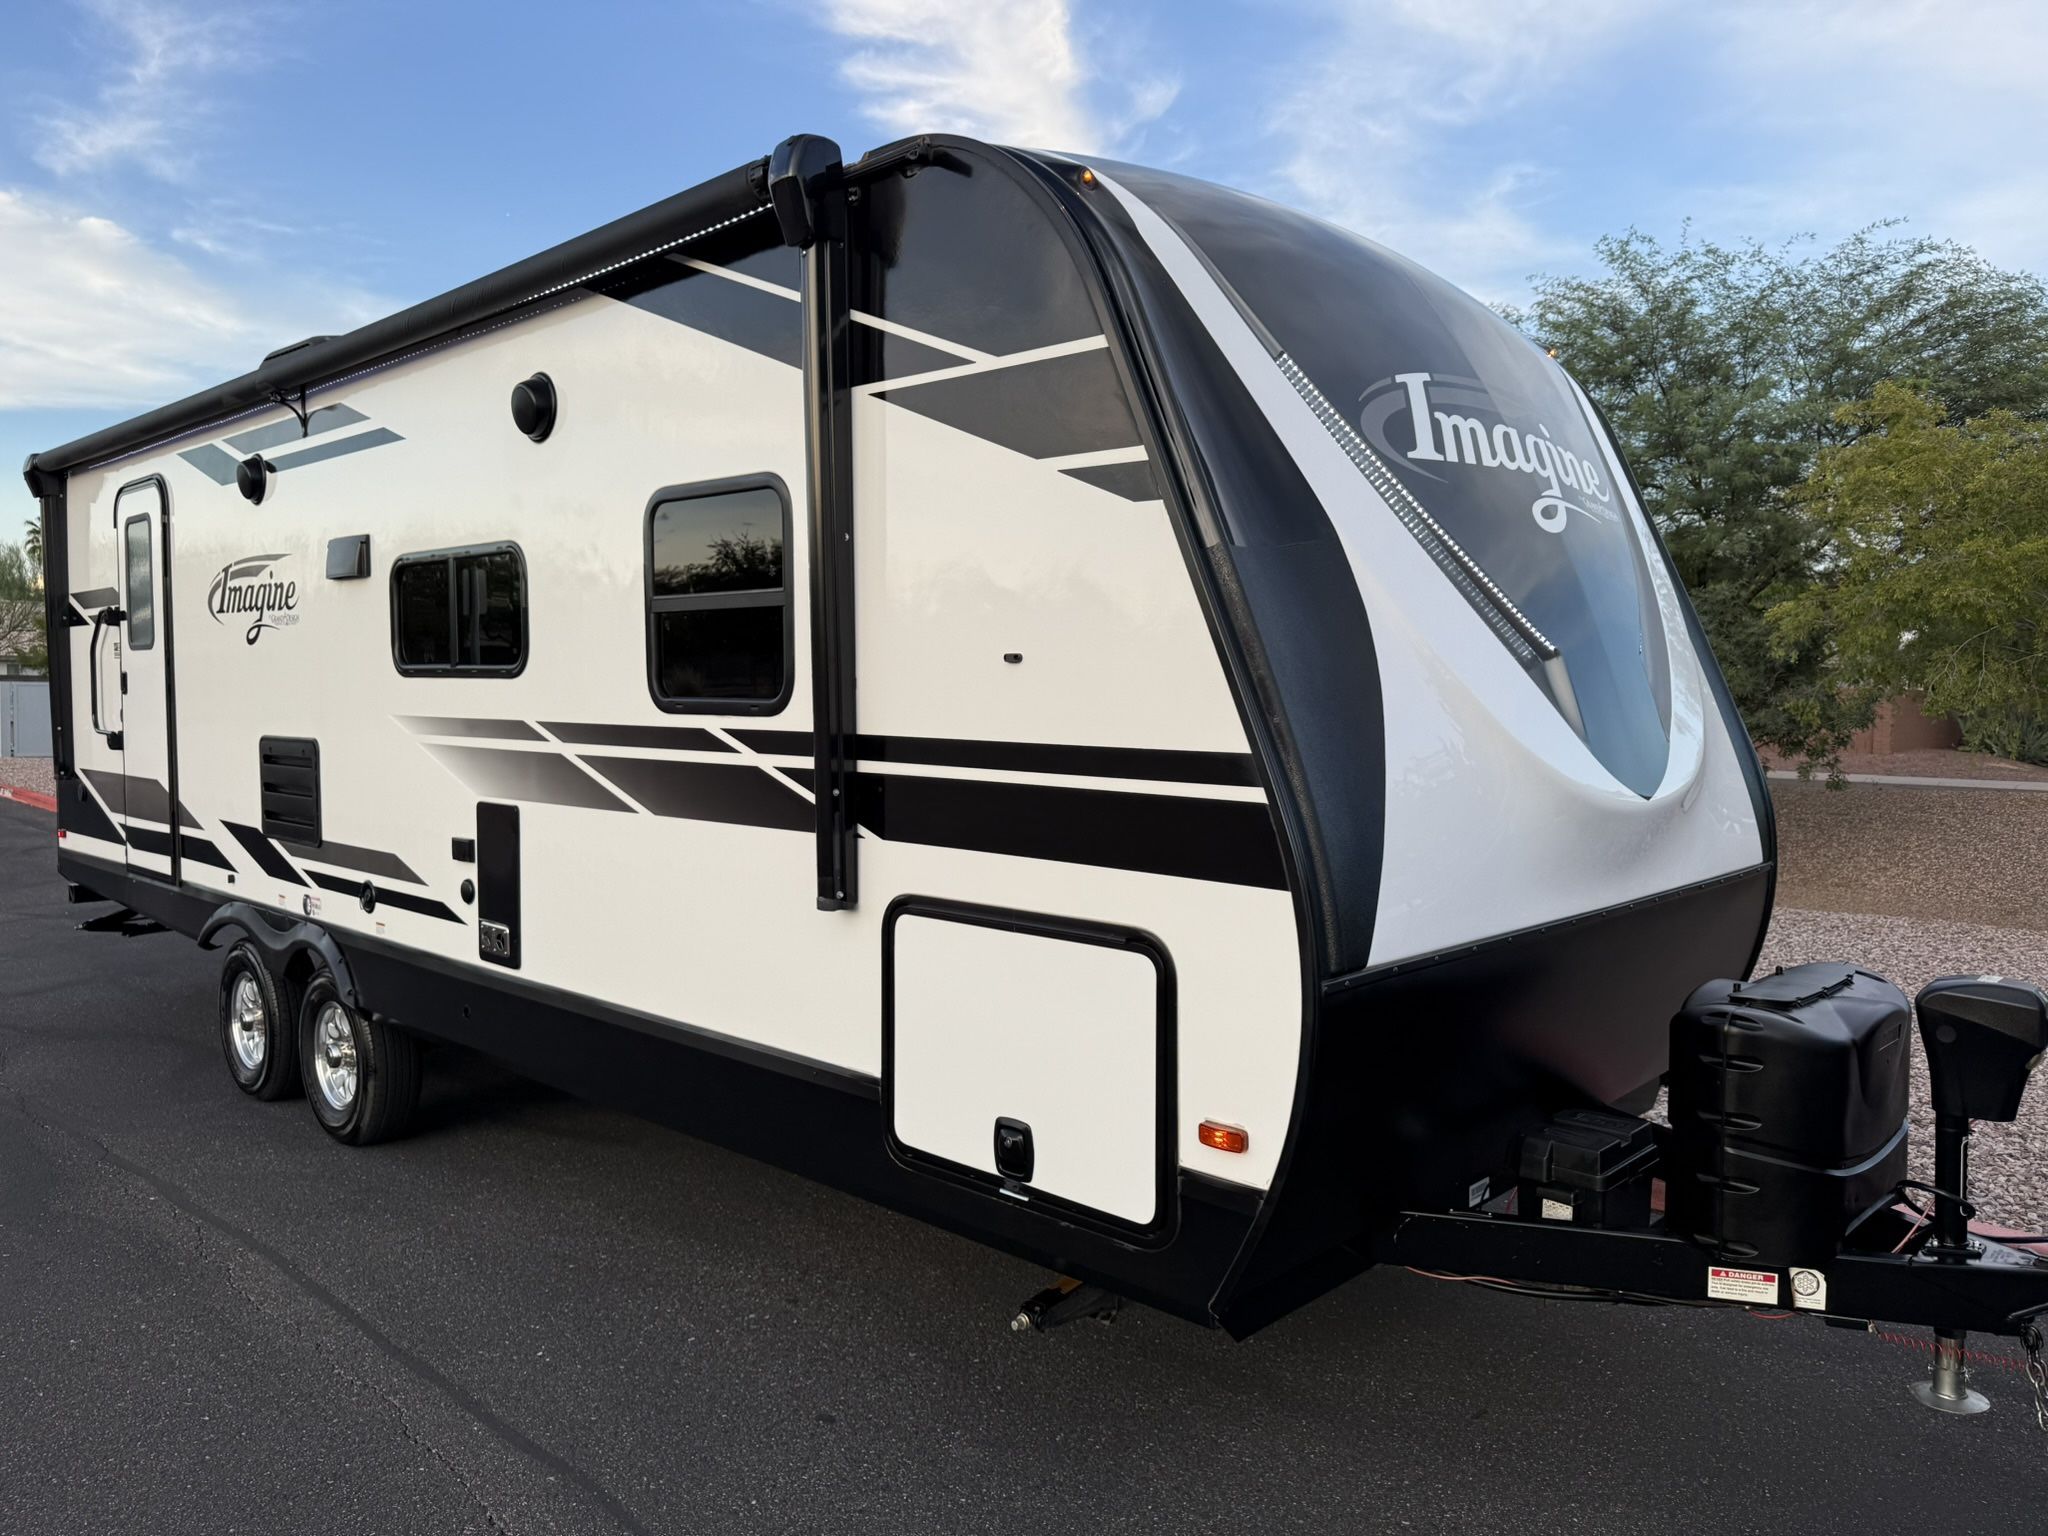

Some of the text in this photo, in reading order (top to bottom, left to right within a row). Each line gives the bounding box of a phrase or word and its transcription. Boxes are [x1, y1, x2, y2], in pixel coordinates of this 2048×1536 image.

[1395, 372, 1610, 533] Imagine
[216, 563, 300, 645] Imagine
[1728, 1271, 1764, 1281] DANGER
